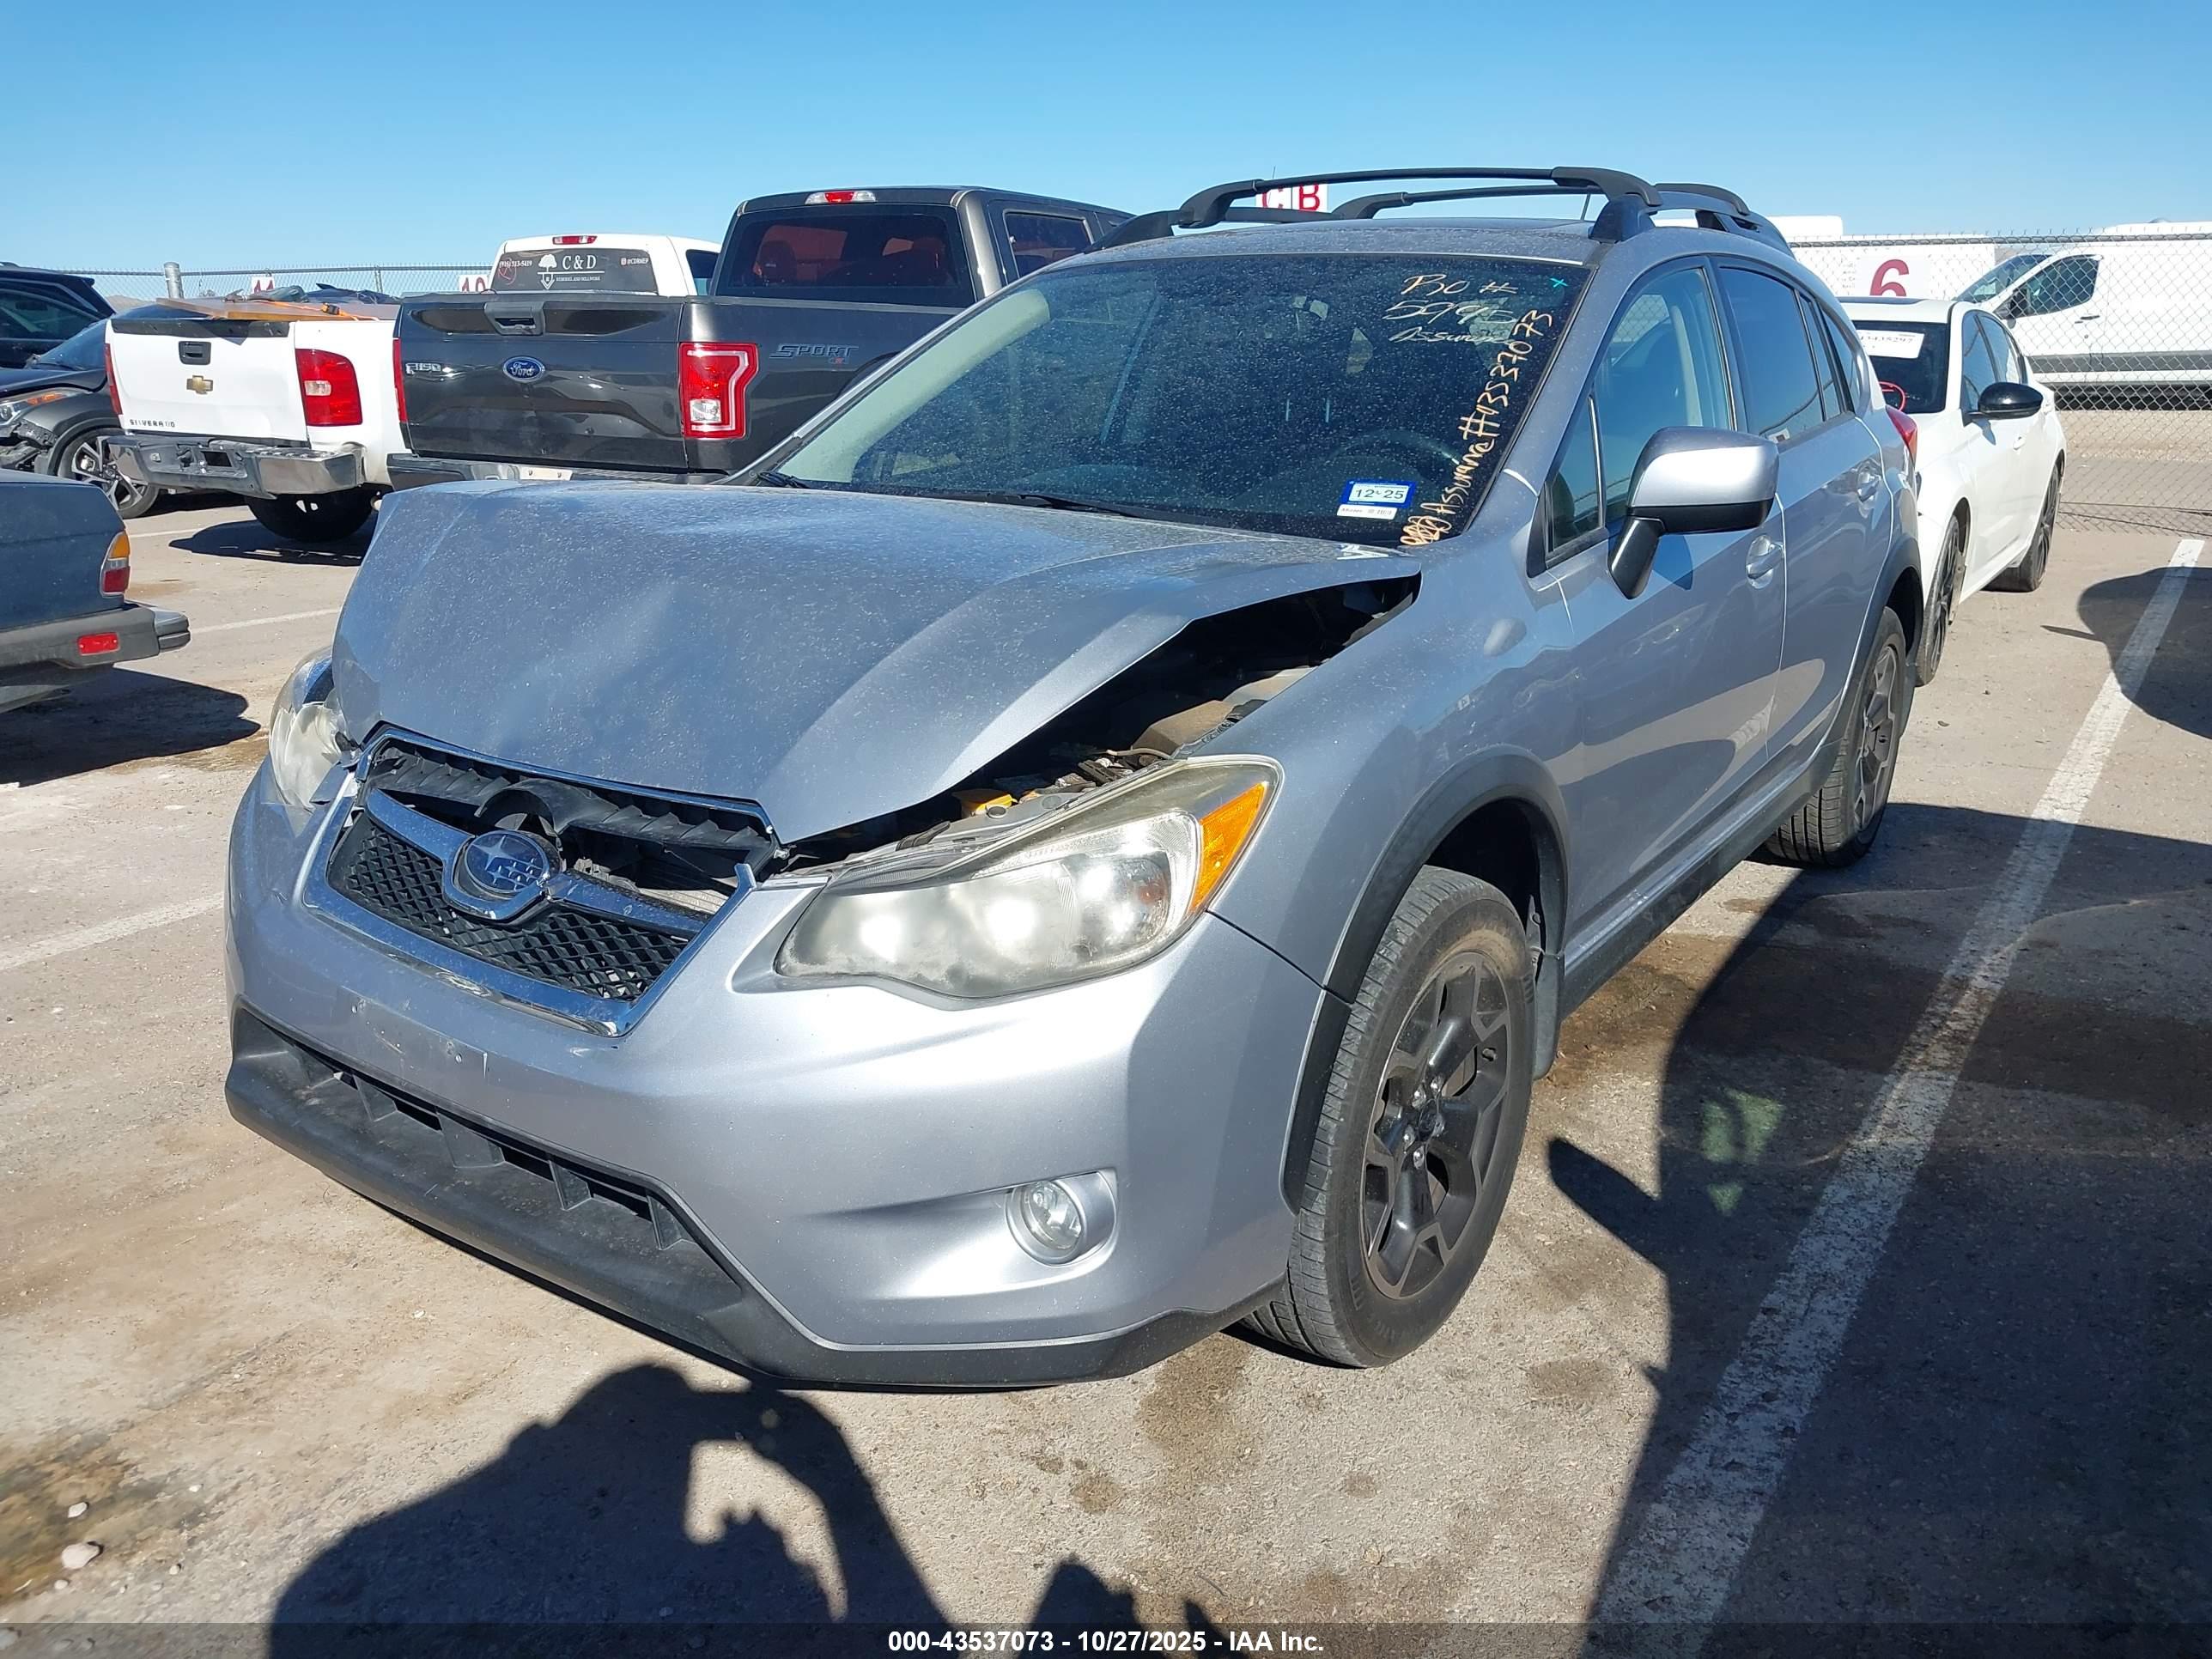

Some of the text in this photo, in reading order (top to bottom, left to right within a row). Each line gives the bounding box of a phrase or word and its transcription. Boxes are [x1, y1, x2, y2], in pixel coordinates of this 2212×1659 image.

[1298, 184, 1321, 211] B
[562, 254, 597, 270] C & D
[1869, 259, 1910, 297] 6
[769, 344, 859, 359] SPORT
[510, 361, 534, 377] Ford
[1355, 489, 1405, 499] 12 25
